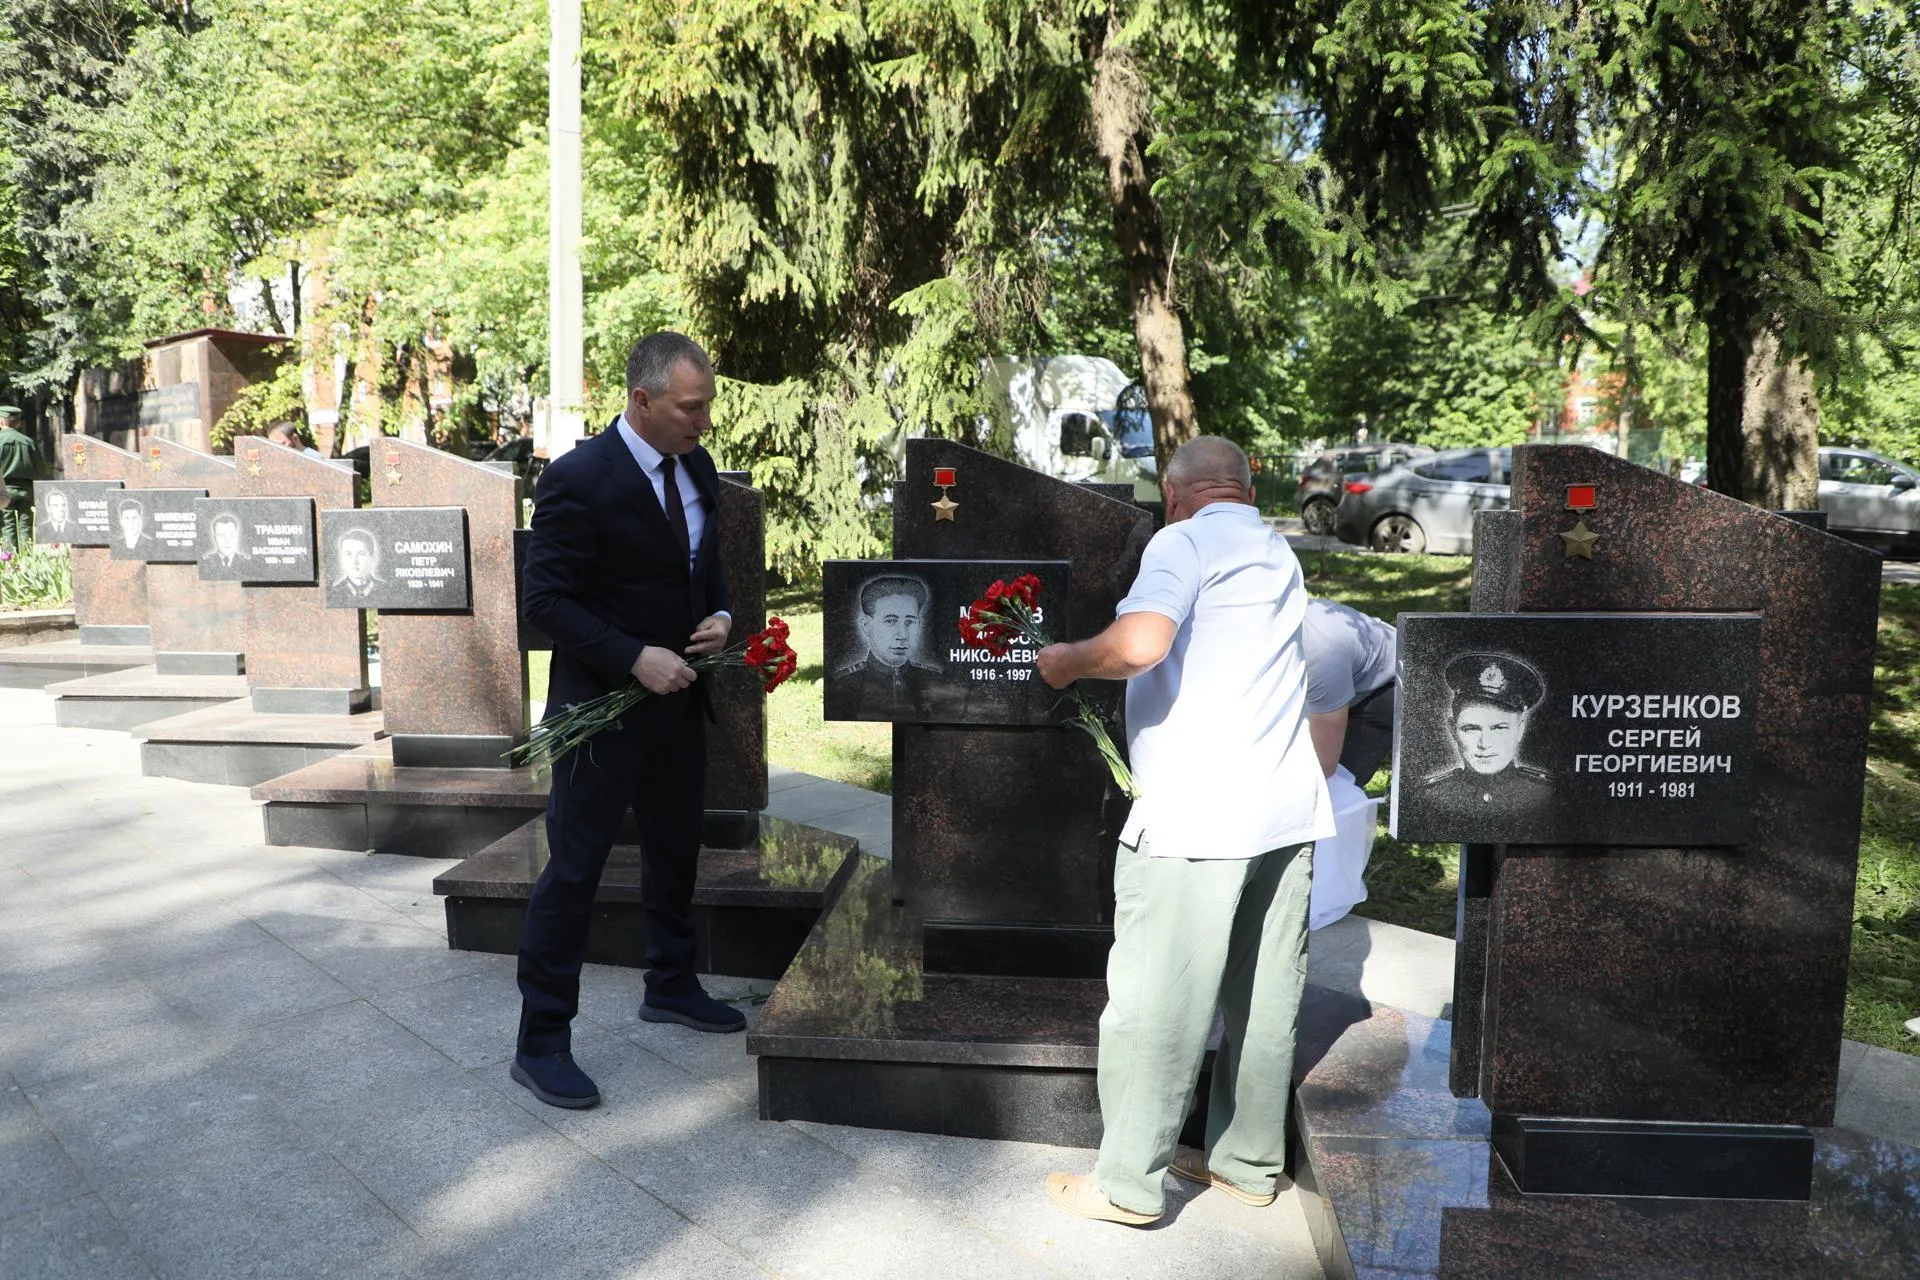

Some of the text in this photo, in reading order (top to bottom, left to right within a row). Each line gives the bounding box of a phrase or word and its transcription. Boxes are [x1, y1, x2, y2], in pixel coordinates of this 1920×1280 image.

[254, 524, 303, 535] ТРАВКИН
[267, 537, 291, 546] ИВАН
[394, 541, 453, 554] САМОХИН
[252, 546, 307, 555] ВАСИЛЬЕВИЧ
[411, 556, 437, 566] ПЕТР
[395, 567, 455, 577] ЯКОВЛЕВИЧ
[949, 648, 1039, 663] НИКОАЕВИ
[970, 668, 996, 680] 1916
[1006, 669, 1032, 681] 1997
[1571, 694, 1741, 719] КУРЗЕНКОВ
[1608, 725, 1701, 748] СЕРГЕЙ
[1575, 754, 1732, 773] ГЕОРГИЕВИЧ
[1608, 781, 1643, 798] 1911
[1659, 782, 1695, 798] 1981
